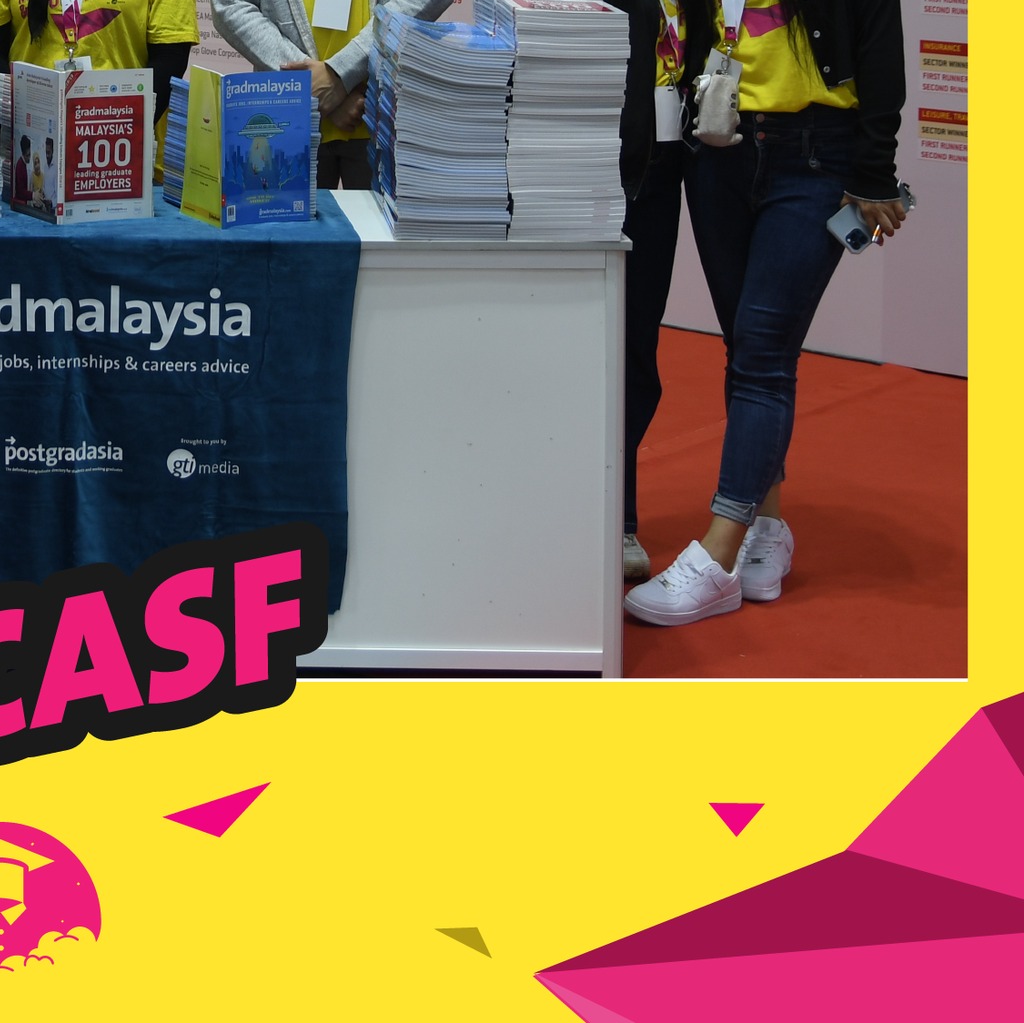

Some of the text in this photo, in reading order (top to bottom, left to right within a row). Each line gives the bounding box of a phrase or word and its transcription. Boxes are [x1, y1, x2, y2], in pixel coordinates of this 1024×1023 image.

[923, 43, 961, 53] INSURANCE
[226, 79, 302, 99] gradmalaysia
[75, 105, 134, 119] gradmalaysia
[75, 124, 133, 136] MALAYSIA'S
[77, 138, 131, 169] 100
[74, 169, 132, 179] leading graduate
[74, 178, 131, 191] EMPLOYERS
[37, 354, 120, 373] internships
[125, 355, 138, 370] &
[142, 358, 197, 372] careers
[201, 358, 250, 374] advice
[5, 441, 123, 466] postgradasia
[172, 457, 240, 478] gti media
